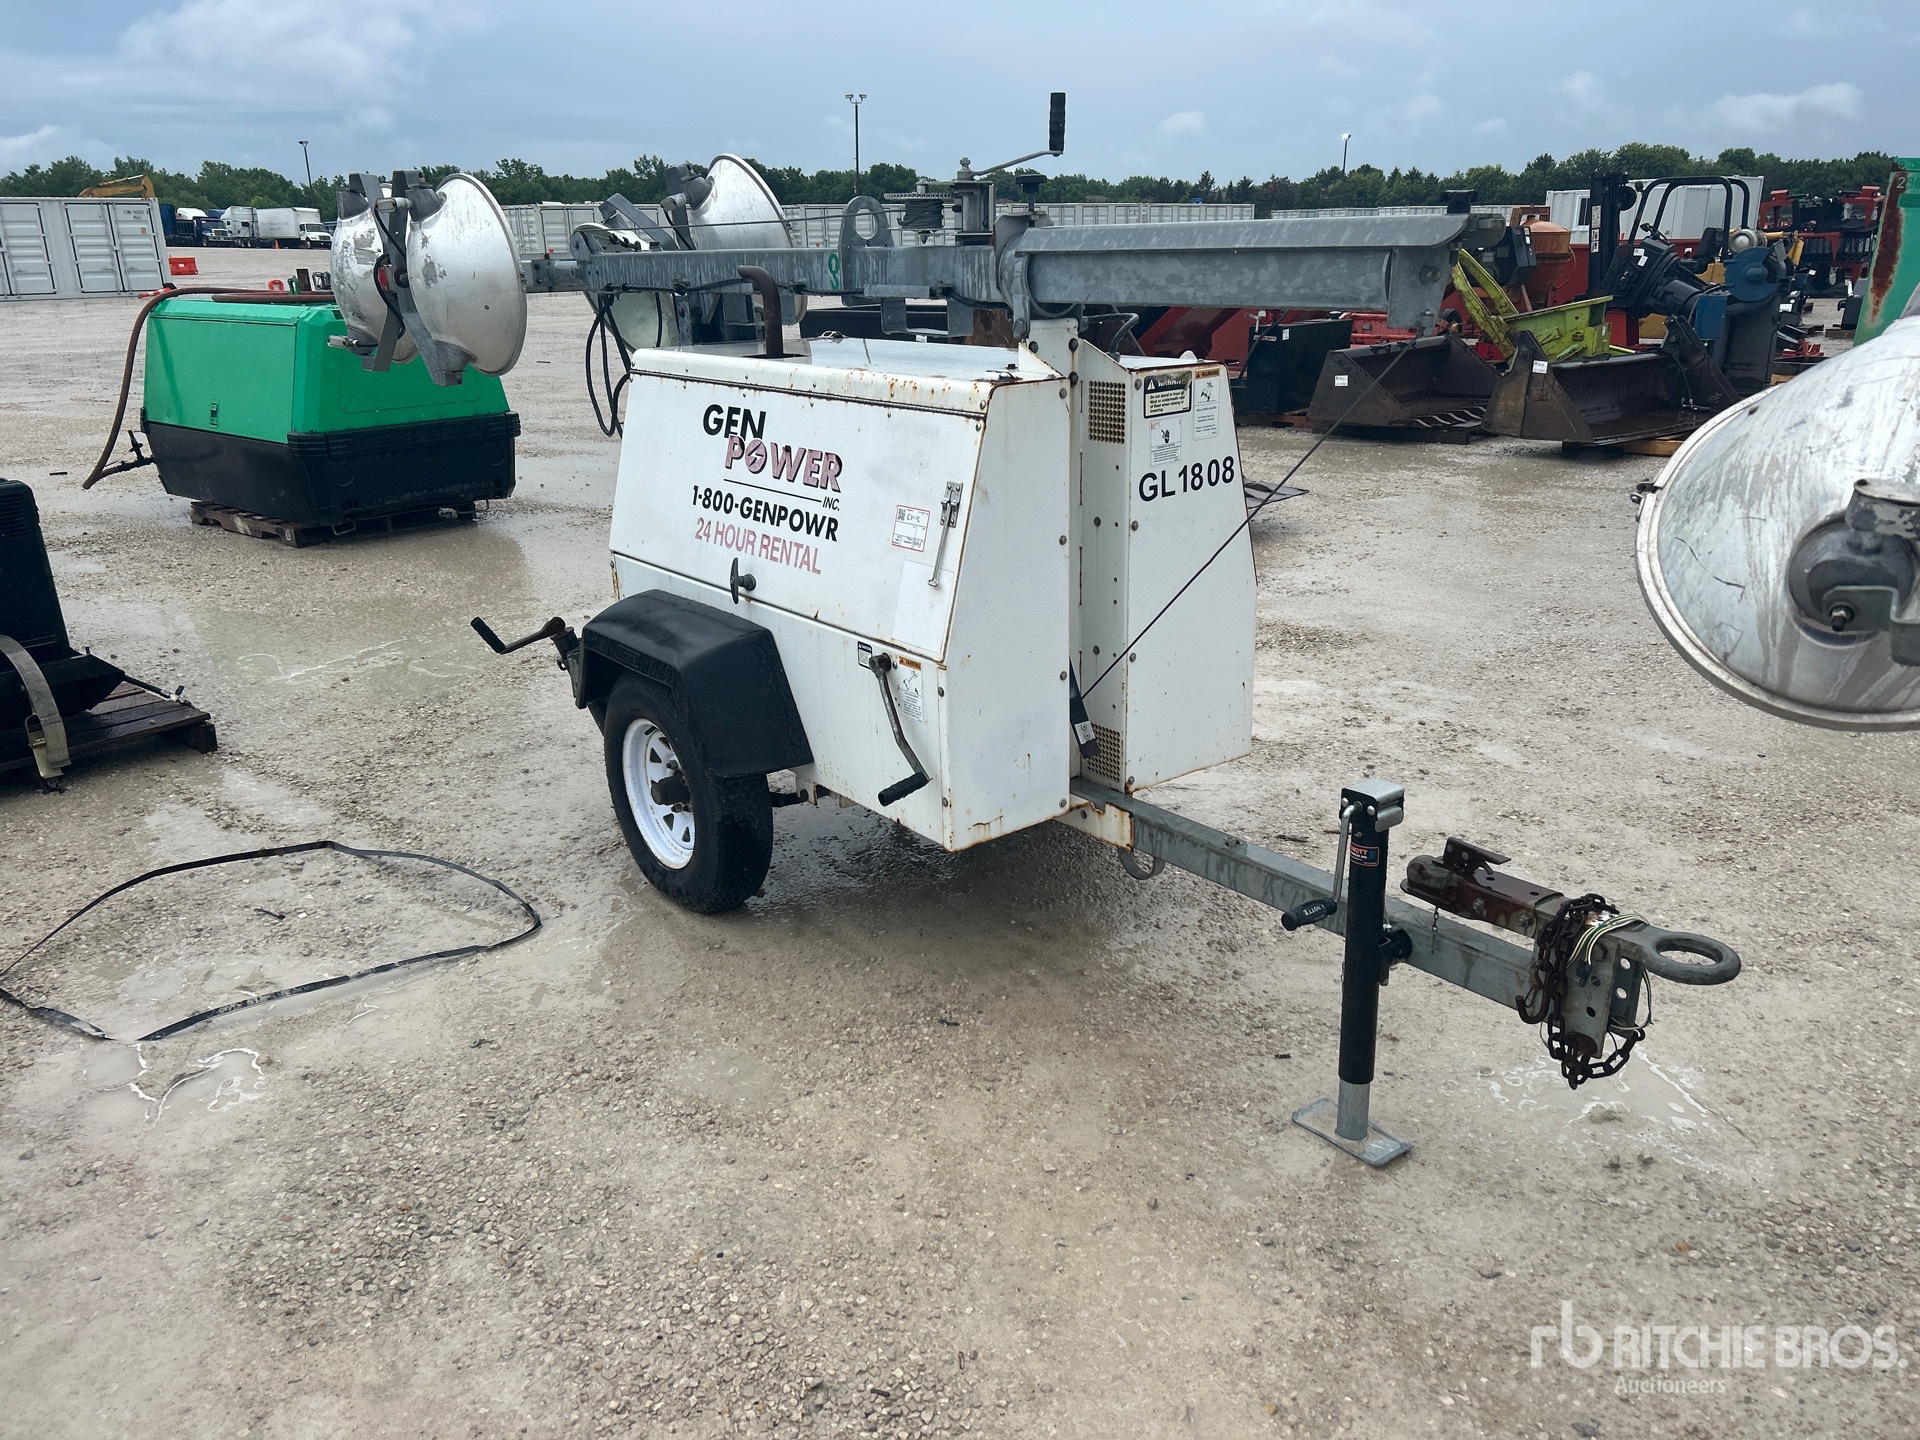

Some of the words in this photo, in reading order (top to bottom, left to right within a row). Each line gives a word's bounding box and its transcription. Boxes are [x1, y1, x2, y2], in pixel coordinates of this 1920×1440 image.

[702, 404, 766, 439] GEN
[724, 435, 843, 493] POWER
[1139, 456, 1234, 501] GL1808
[692, 485, 839, 542] 1-800-GENPOWR
[822, 496, 840, 511] INC.
[695, 517, 711, 541] 24
[714, 522, 757, 556] HOUR
[759, 534, 822, 575] RENTAL
